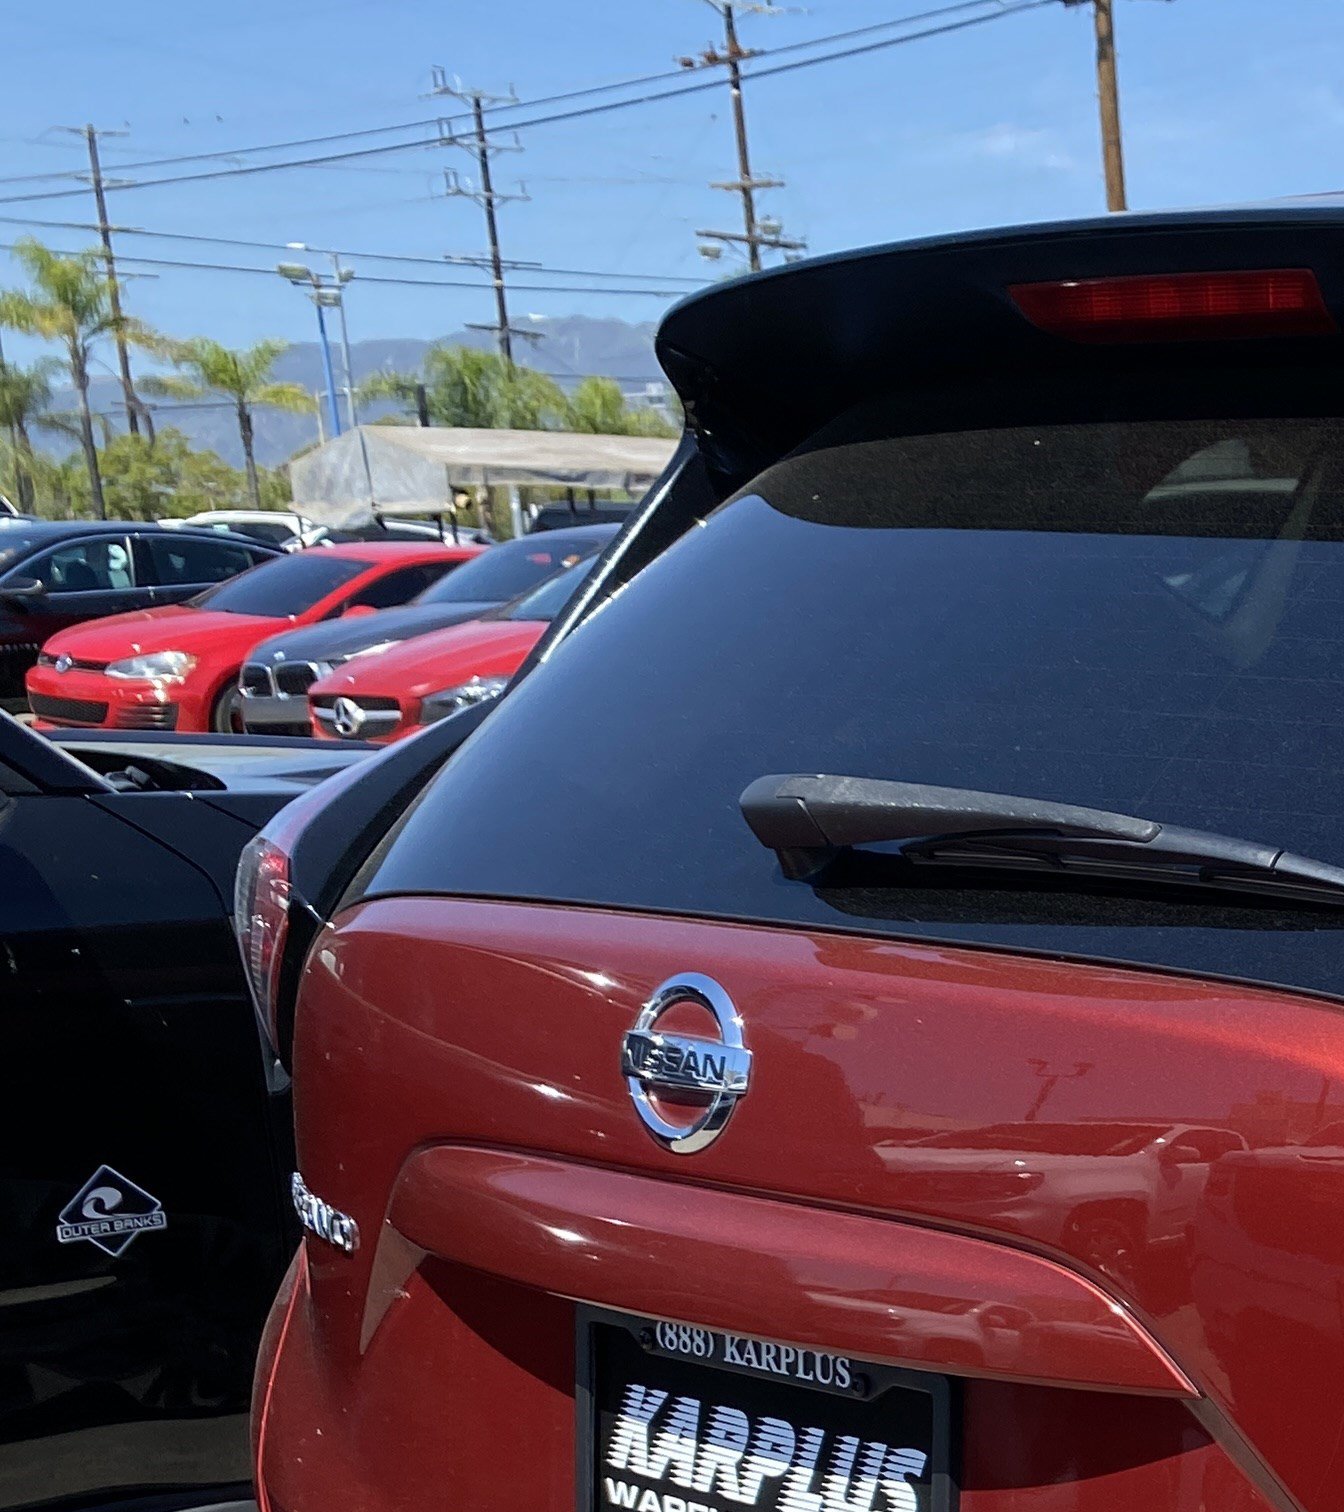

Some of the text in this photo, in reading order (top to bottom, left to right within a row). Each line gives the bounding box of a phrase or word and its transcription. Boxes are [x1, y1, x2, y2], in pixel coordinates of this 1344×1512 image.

[62, 1213, 161, 1239] OUTER BANKS
[655, 1321, 851, 1388] (888) KARPLUS
